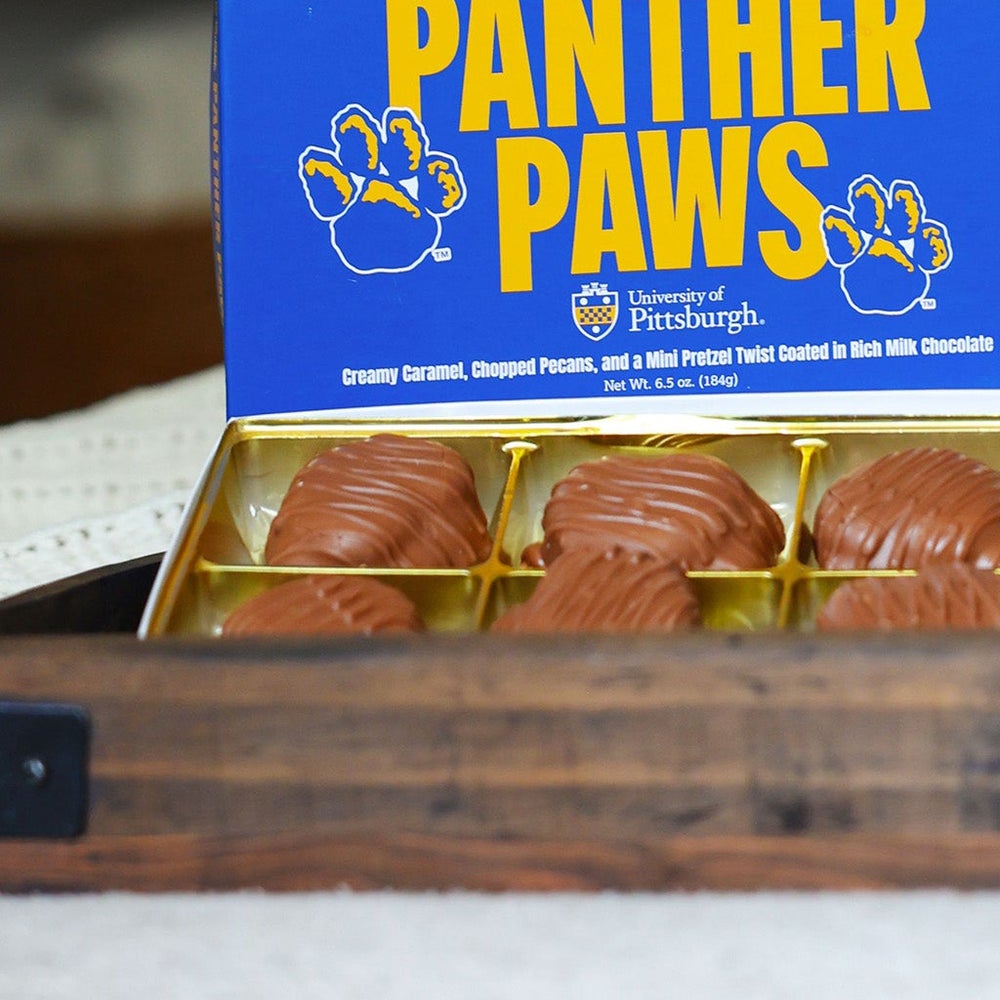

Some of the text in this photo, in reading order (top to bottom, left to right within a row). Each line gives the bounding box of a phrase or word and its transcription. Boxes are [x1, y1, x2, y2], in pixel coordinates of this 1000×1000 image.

[497, 123, 827, 292] PAWS
[627, 286, 727, 305] University of
[342, 334, 994, 386] Creamy Caramel, Chopped Pecans, and a Mini Pretzel Twist Coated in Rich Milk Chocolate
[603, 372, 739, 392] Net Wt. 6.5 oz. (184g)
